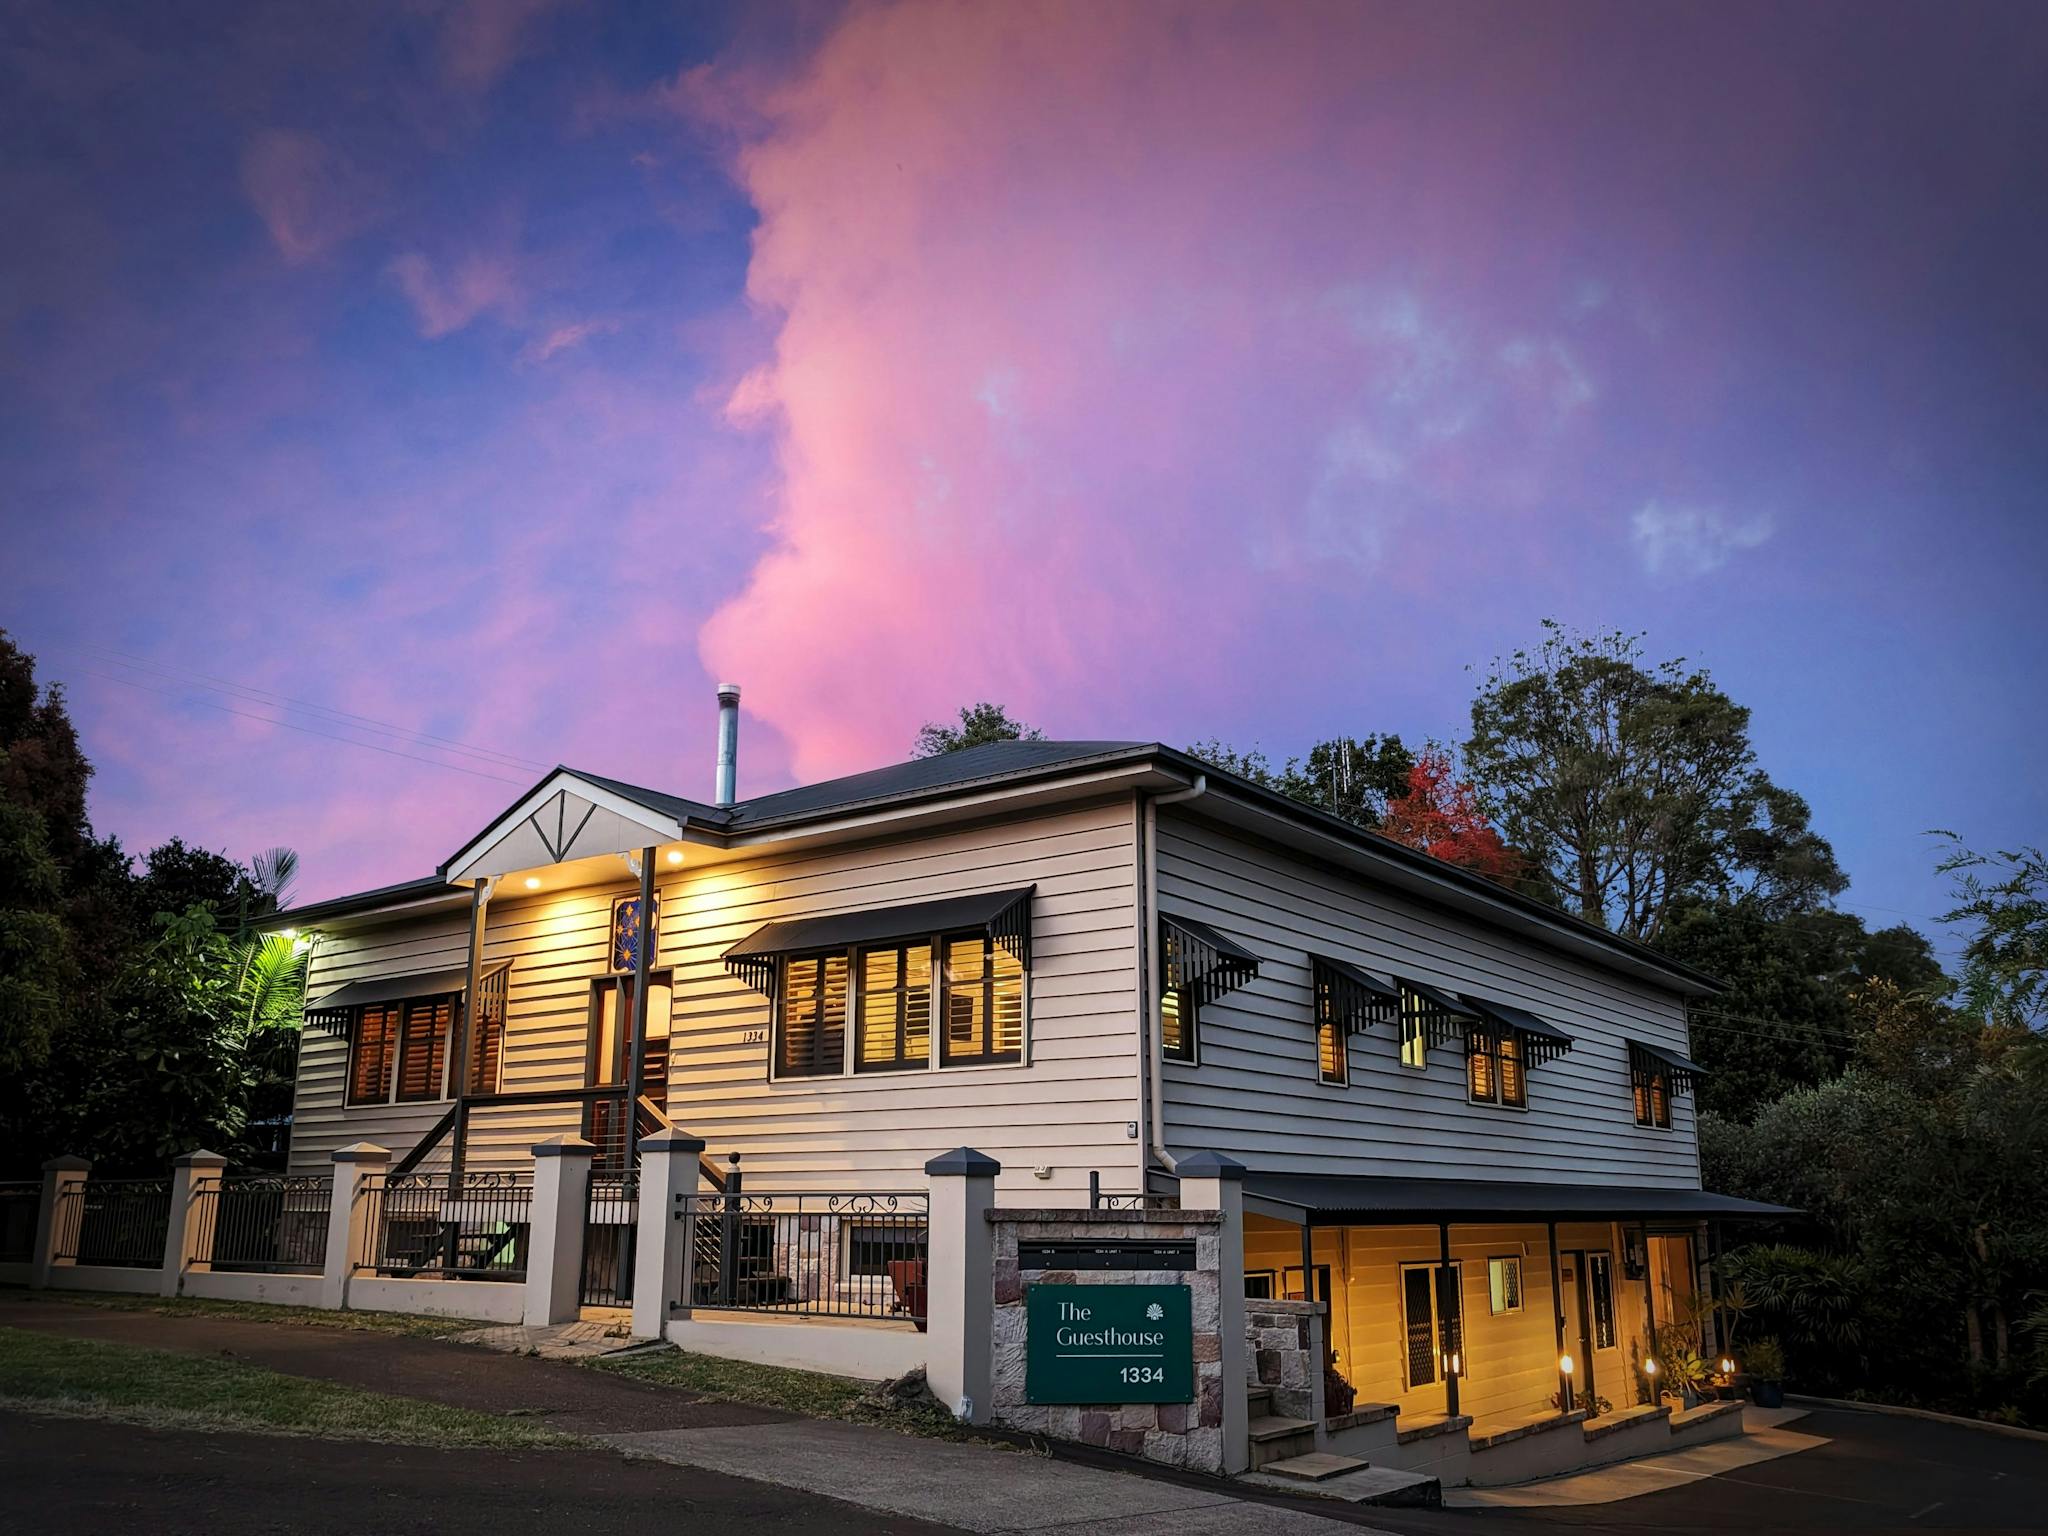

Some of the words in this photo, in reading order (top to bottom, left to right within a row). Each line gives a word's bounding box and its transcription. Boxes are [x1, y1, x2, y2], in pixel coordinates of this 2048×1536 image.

[743, 1031, 764, 1043] 1334
[1057, 1302, 1092, 1321] The
[1056, 1326, 1164, 1346] Guesthouse
[1120, 1367, 1165, 1384] 1334
